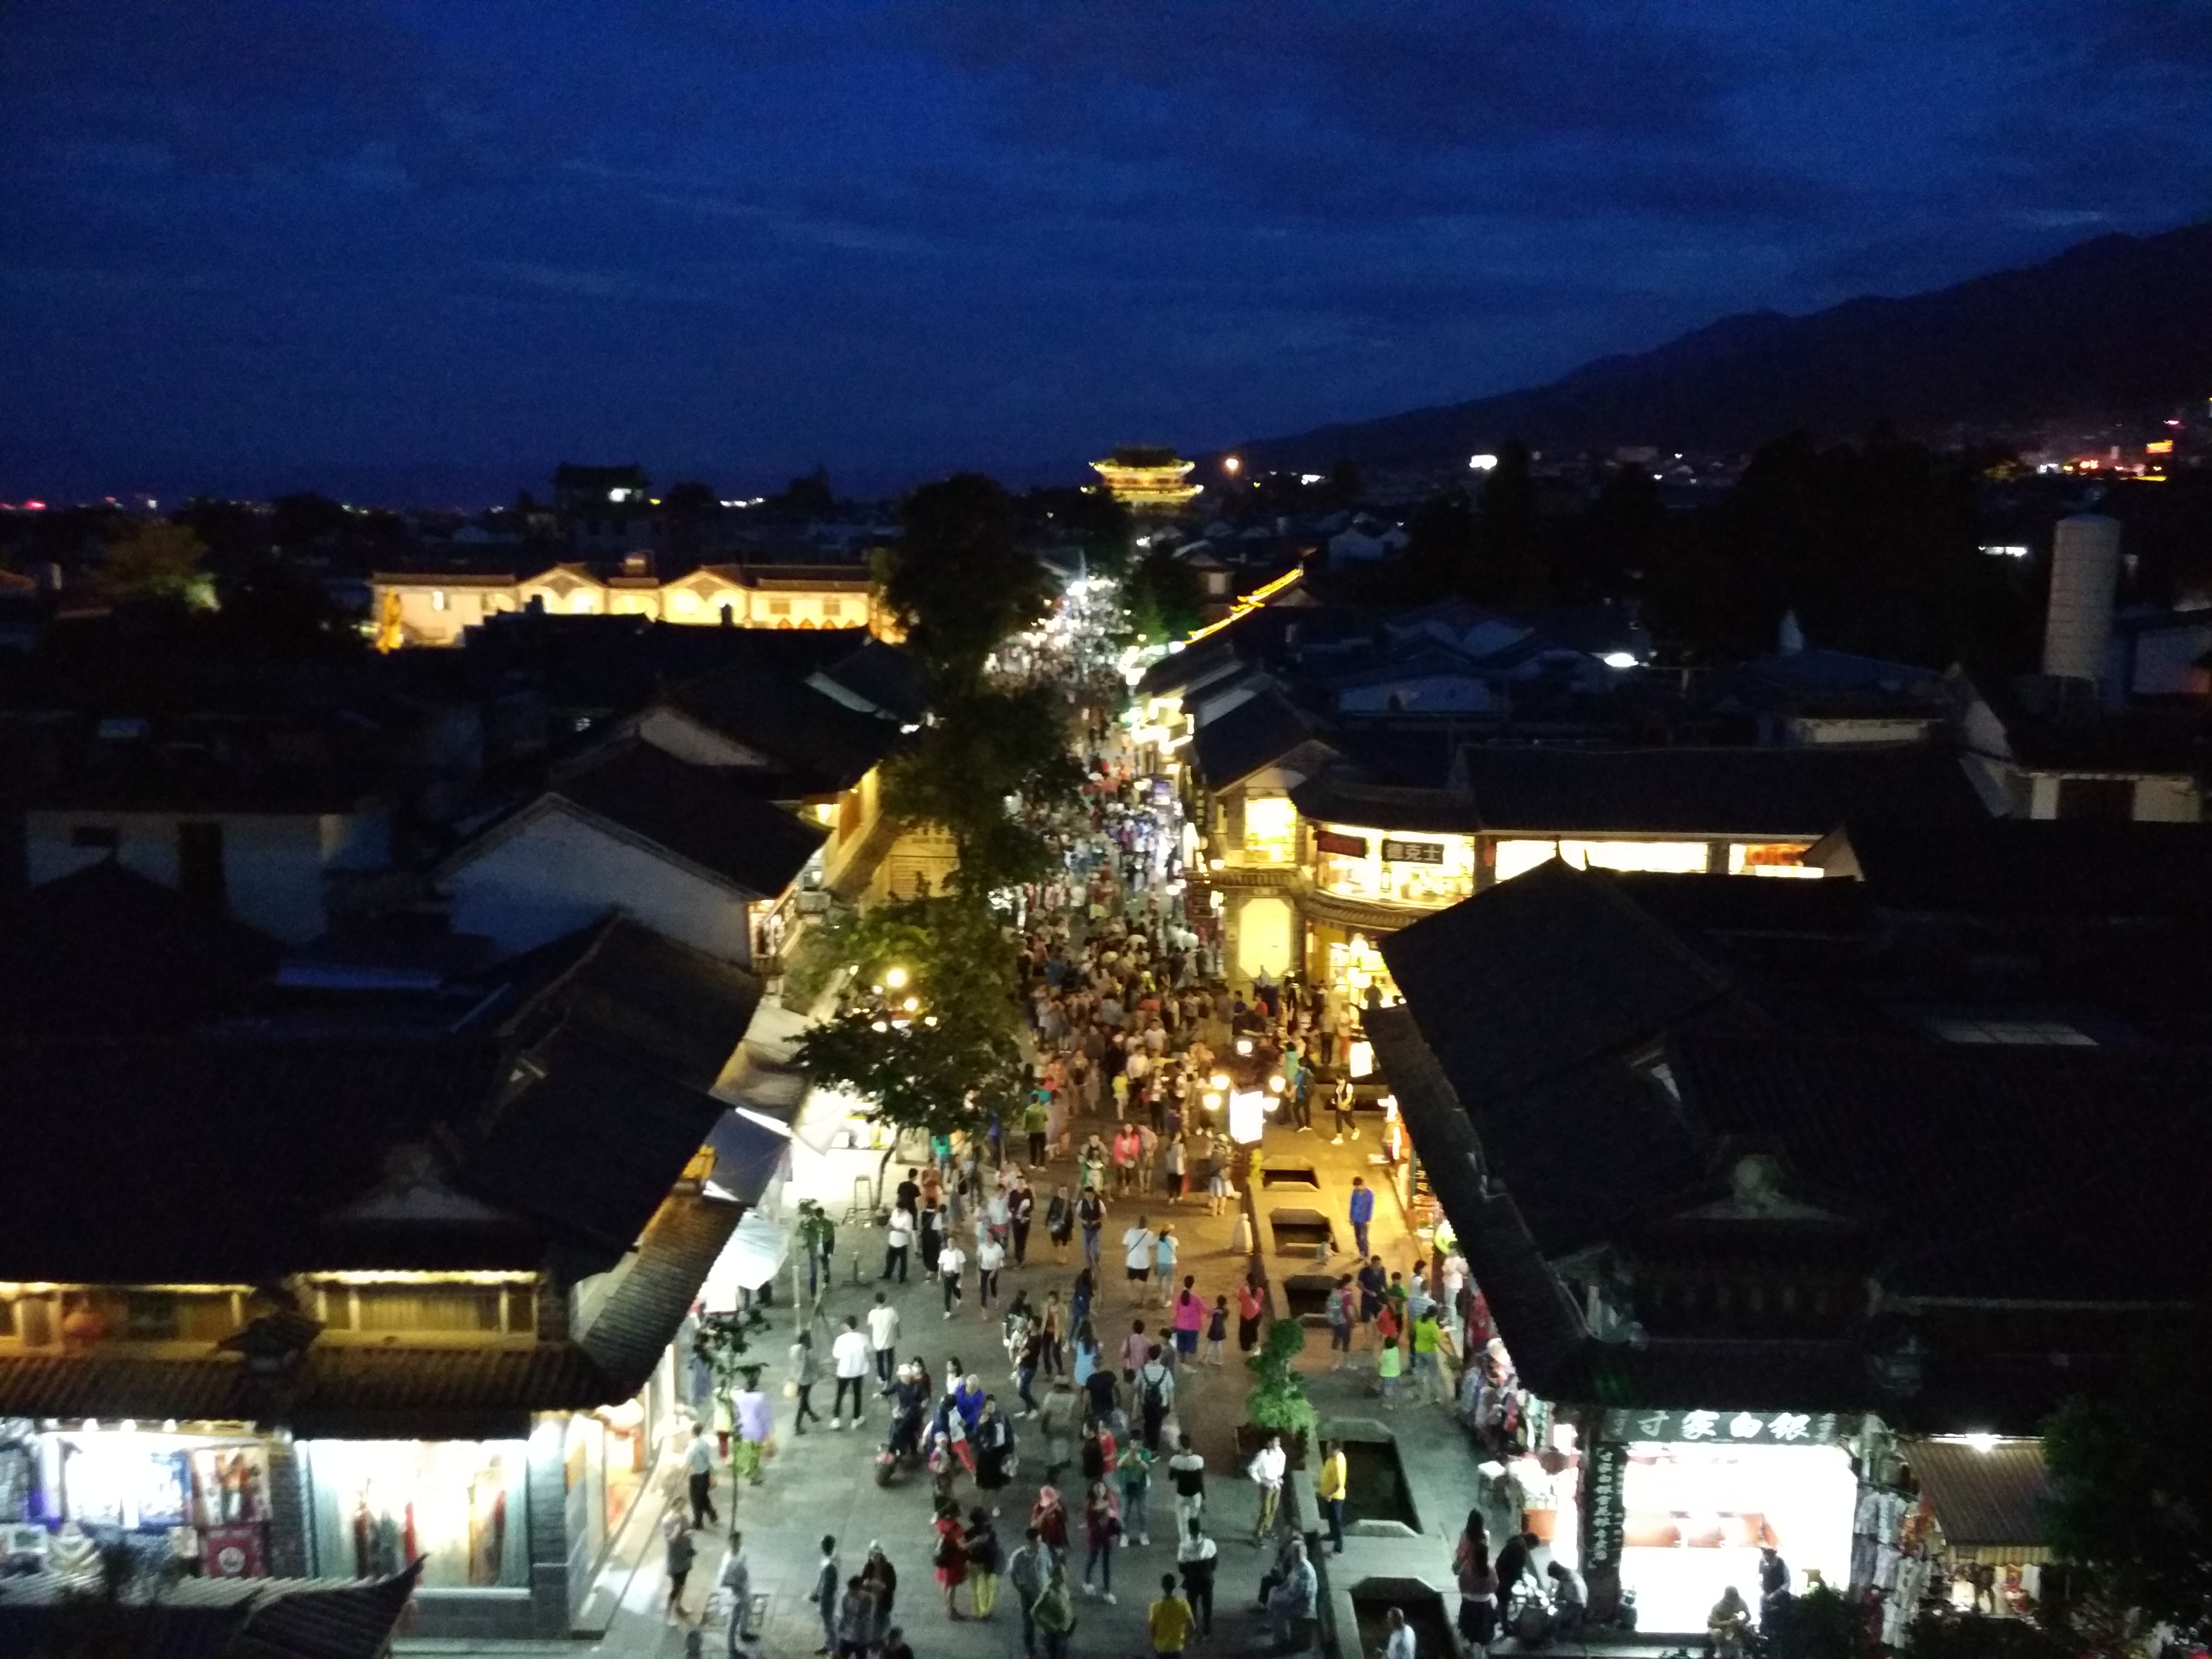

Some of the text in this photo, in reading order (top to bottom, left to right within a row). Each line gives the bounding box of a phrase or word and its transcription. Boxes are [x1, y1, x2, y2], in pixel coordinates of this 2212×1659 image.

[1386, 843, 1440, 861] 德克士
[1637, 1409, 1812, 1440] 寸家白银
